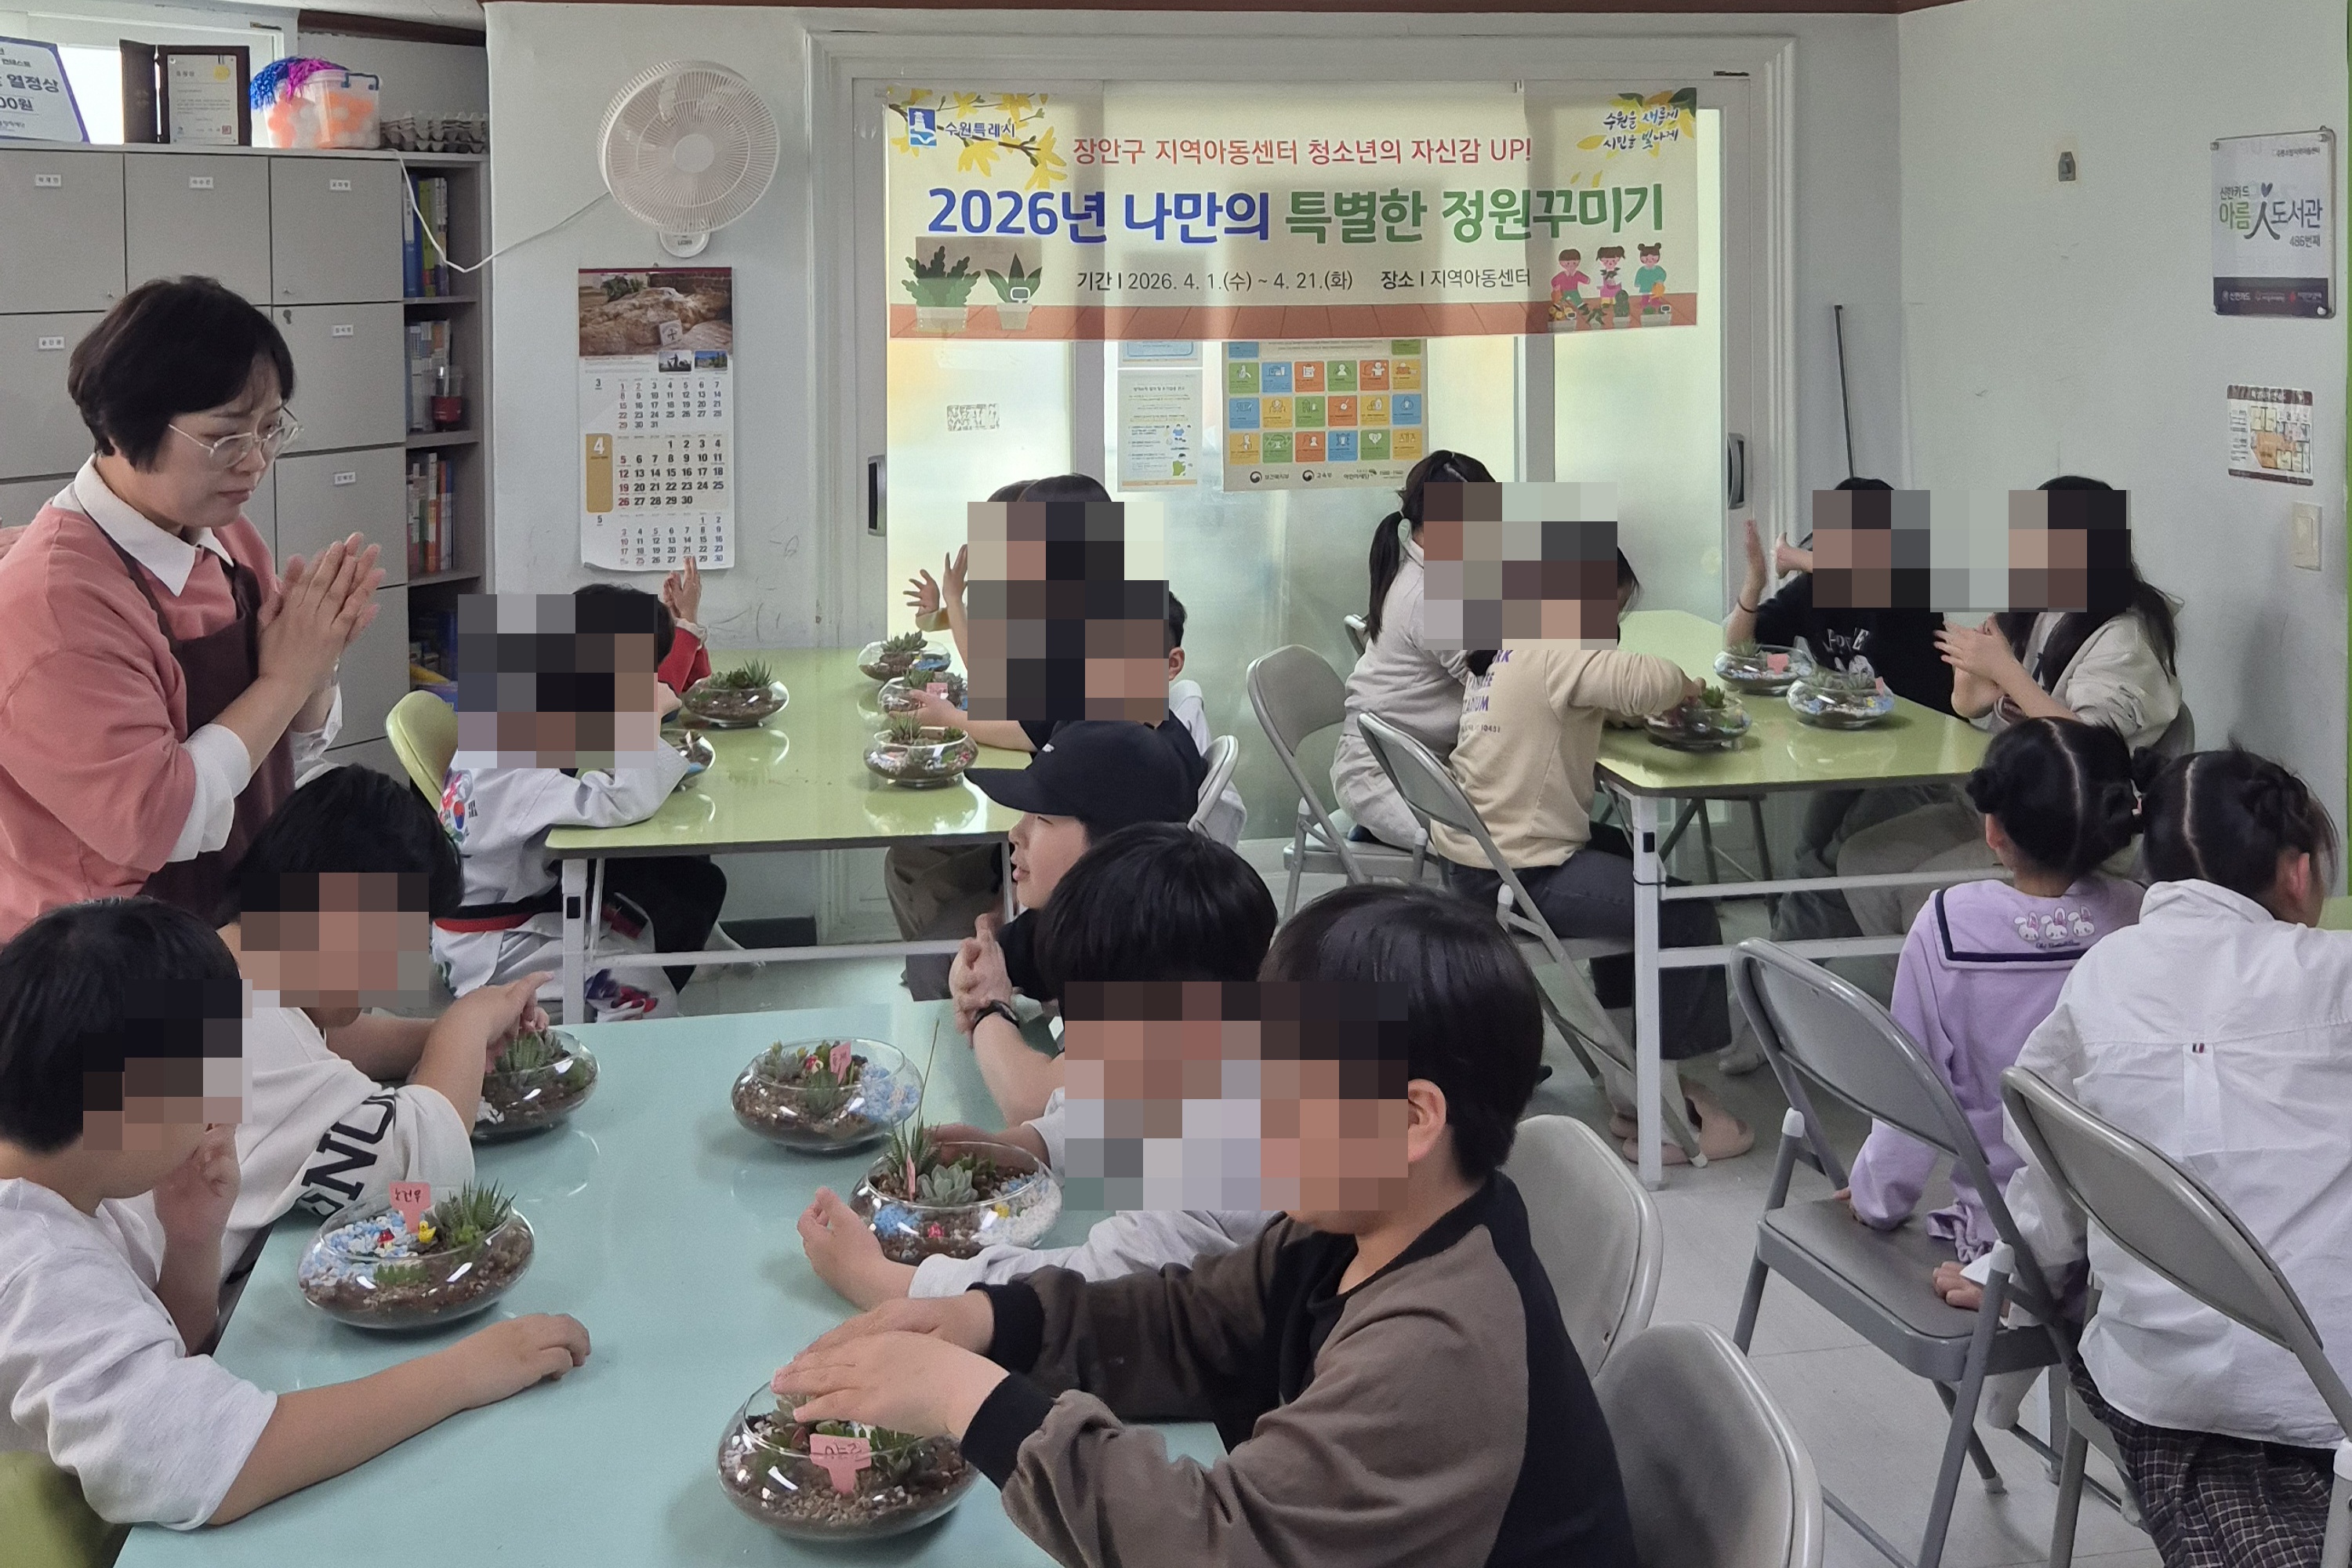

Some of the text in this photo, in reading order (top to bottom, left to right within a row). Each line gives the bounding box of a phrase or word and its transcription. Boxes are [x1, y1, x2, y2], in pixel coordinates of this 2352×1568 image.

[6, 74, 59, 93] 열정상
[1603, 111, 1636, 130] 수원을
[1603, 129, 1679, 150] 시민을 빛나게
[1073, 138, 1532, 165] 장안구 지역아동센터 청소년의 자신감 UP!
[2220, 186, 2250, 200] 신한카드
[927, 183, 1663, 245] 2026년 나만의 특별한 정원꾸미기
[1076, 272, 1112, 292] 기간
[1127, 273, 1178, 291] 2026.
[1183, 273, 1200, 291] 4.
[1207, 270, 1252, 293] 1.(수)
[1273, 271, 1290, 291] 4.
[1297, 269, 1353, 292] 21.(화)
[1381, 270, 1414, 291] 장소
[1430, 268, 1530, 288] 지역아동센터
[593, 437, 605, 455] 4
[637, 455, 643, 463] 6
[668, 454, 674, 463] 8
[698, 467, 707, 476] 17
[634, 483, 644, 492] 20
[666, 482, 677, 491] 22
